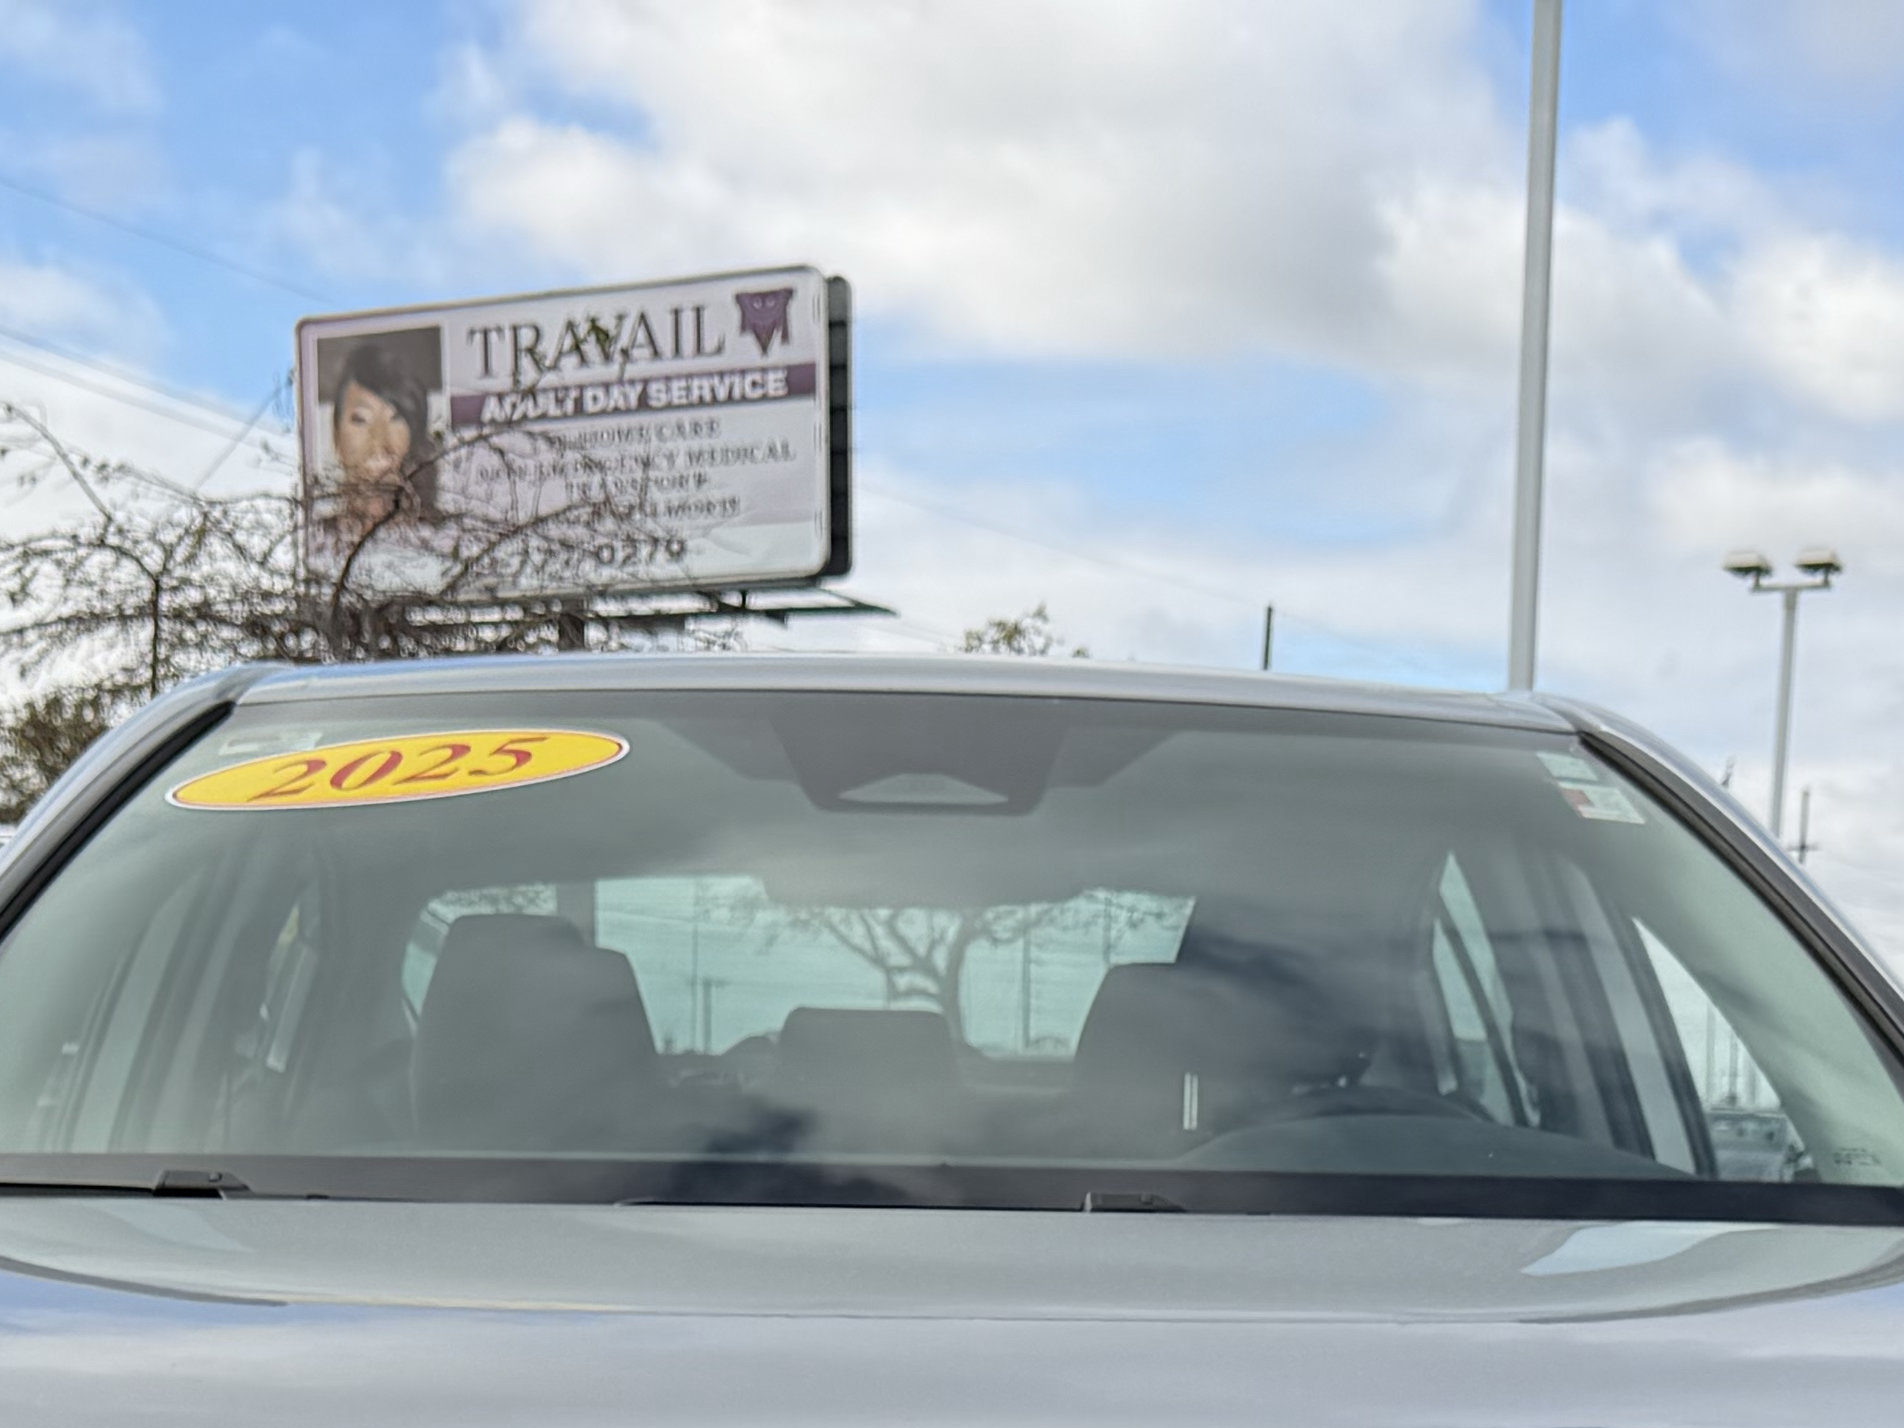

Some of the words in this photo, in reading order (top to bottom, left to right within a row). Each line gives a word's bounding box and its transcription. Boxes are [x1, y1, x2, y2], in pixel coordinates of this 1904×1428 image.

[466, 305, 726, 379] TRAVAIL
[583, 381, 645, 414] DAY
[647, 369, 788, 408] SERVICE
[246, 737, 549, 801] 2025
